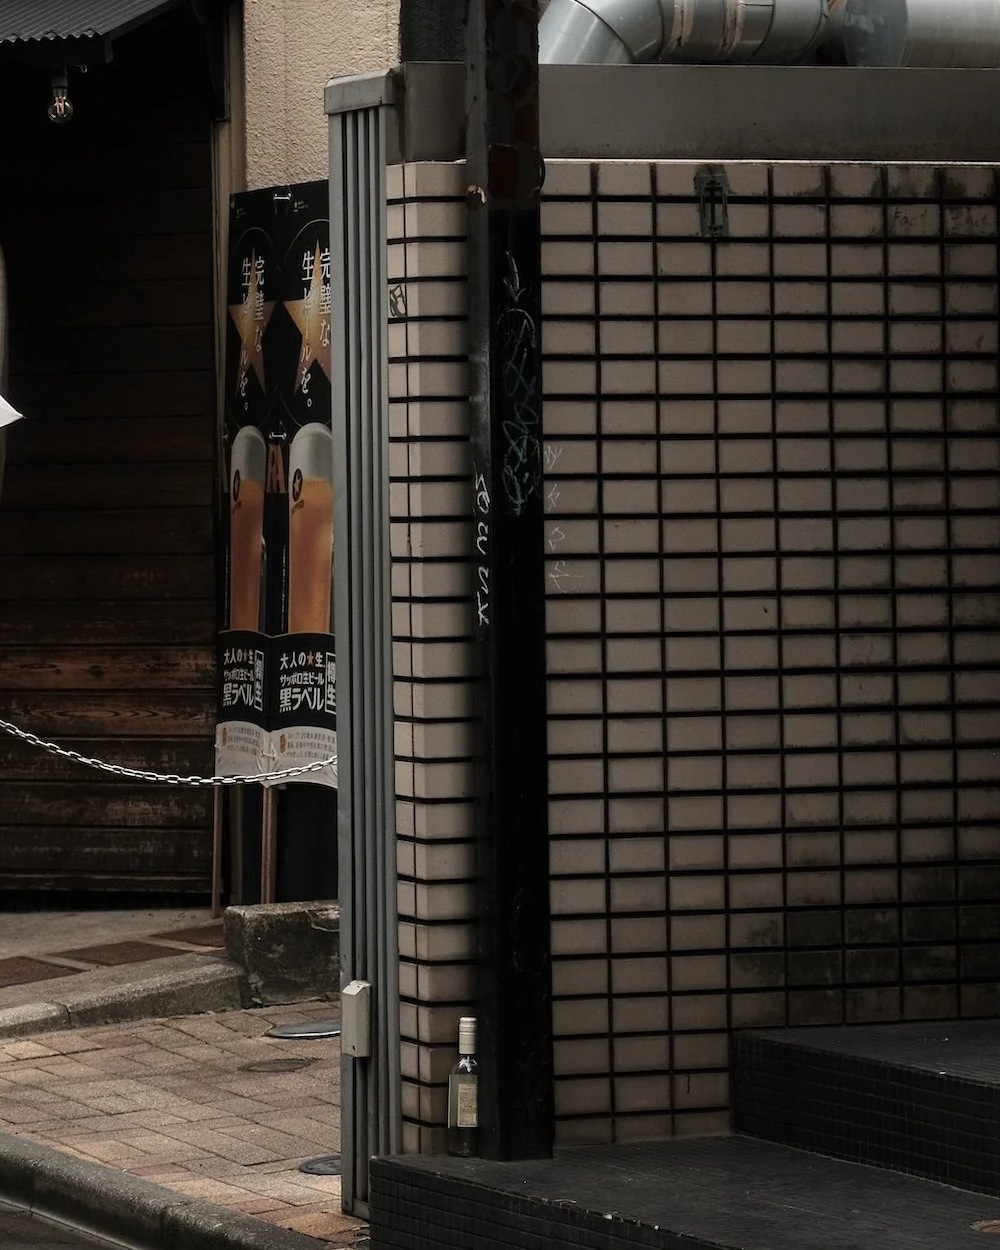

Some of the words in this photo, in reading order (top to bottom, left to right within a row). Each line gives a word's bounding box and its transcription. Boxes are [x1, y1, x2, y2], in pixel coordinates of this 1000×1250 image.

[280, 670, 324, 687] サッポロ生ビール
[223, 682, 254, 707] 黒ラベル
[280, 687, 324, 713] 黒ラベル
